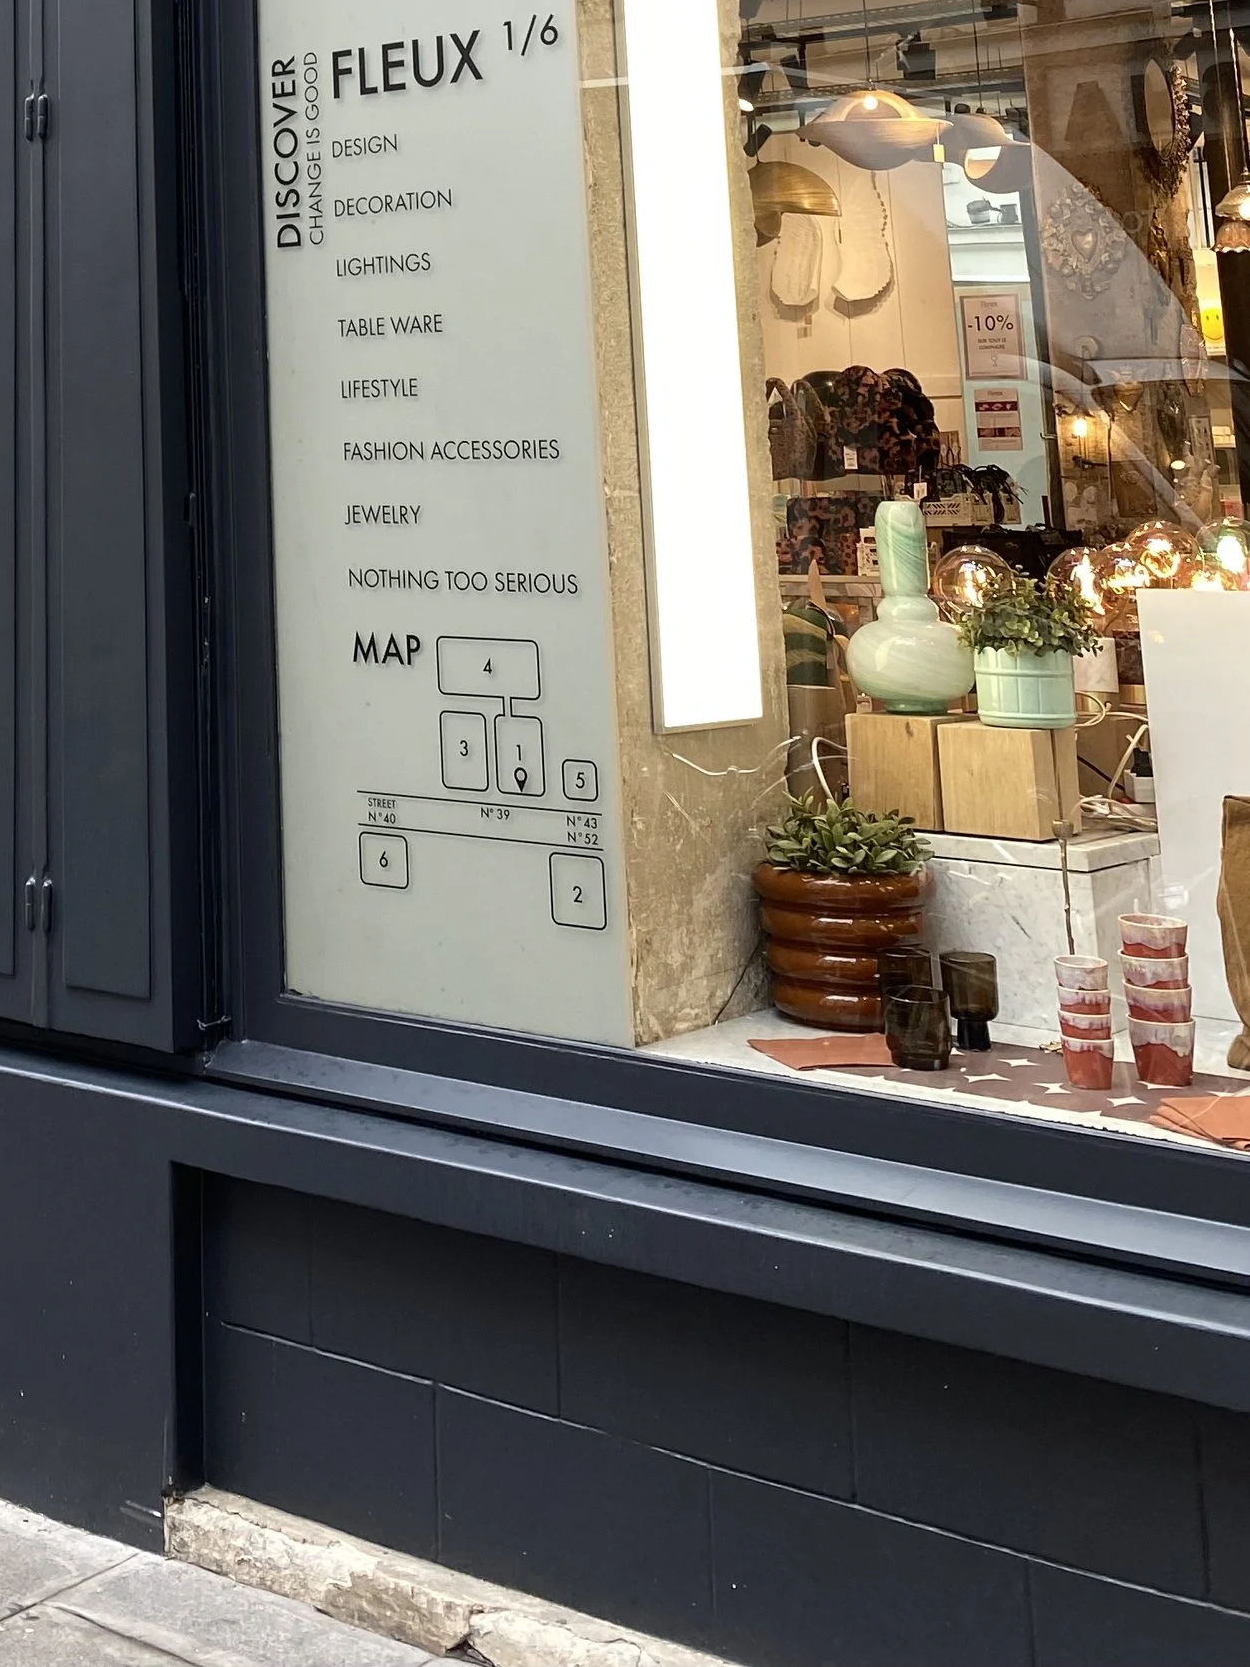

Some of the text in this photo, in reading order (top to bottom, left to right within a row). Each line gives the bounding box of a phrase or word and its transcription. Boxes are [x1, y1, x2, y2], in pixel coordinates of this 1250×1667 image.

[332, 14, 558, 99] FLEUX 1/6
[272, 56, 301, 248] DISCOVER
[304, 53, 323, 245] CHANGE IS GOOD
[333, 134, 397, 158] DESIGN
[335, 189, 451, 217] DECORATION
[337, 253, 430, 276] LIGHTINGS
[338, 315, 442, 336] TABLE WARE
[967, 314, 1014, 332] -10%
[342, 379, 417, 398] LIFESTYLE
[344, 440, 559, 460] FASHION ACCESSORIES
[345, 506, 420, 525] JEWELRY
[349, 569, 577, 594] NOTHING TOO SERIOUS
[353, 632, 420, 665] MAP
[483, 659, 492, 674] 4
[460, 740, 468, 756] 3
[576, 772, 585, 788] 5
[368, 798, 396, 809] STREET
[380, 851, 388, 867] 6
[573, 886, 582, 903] 2
